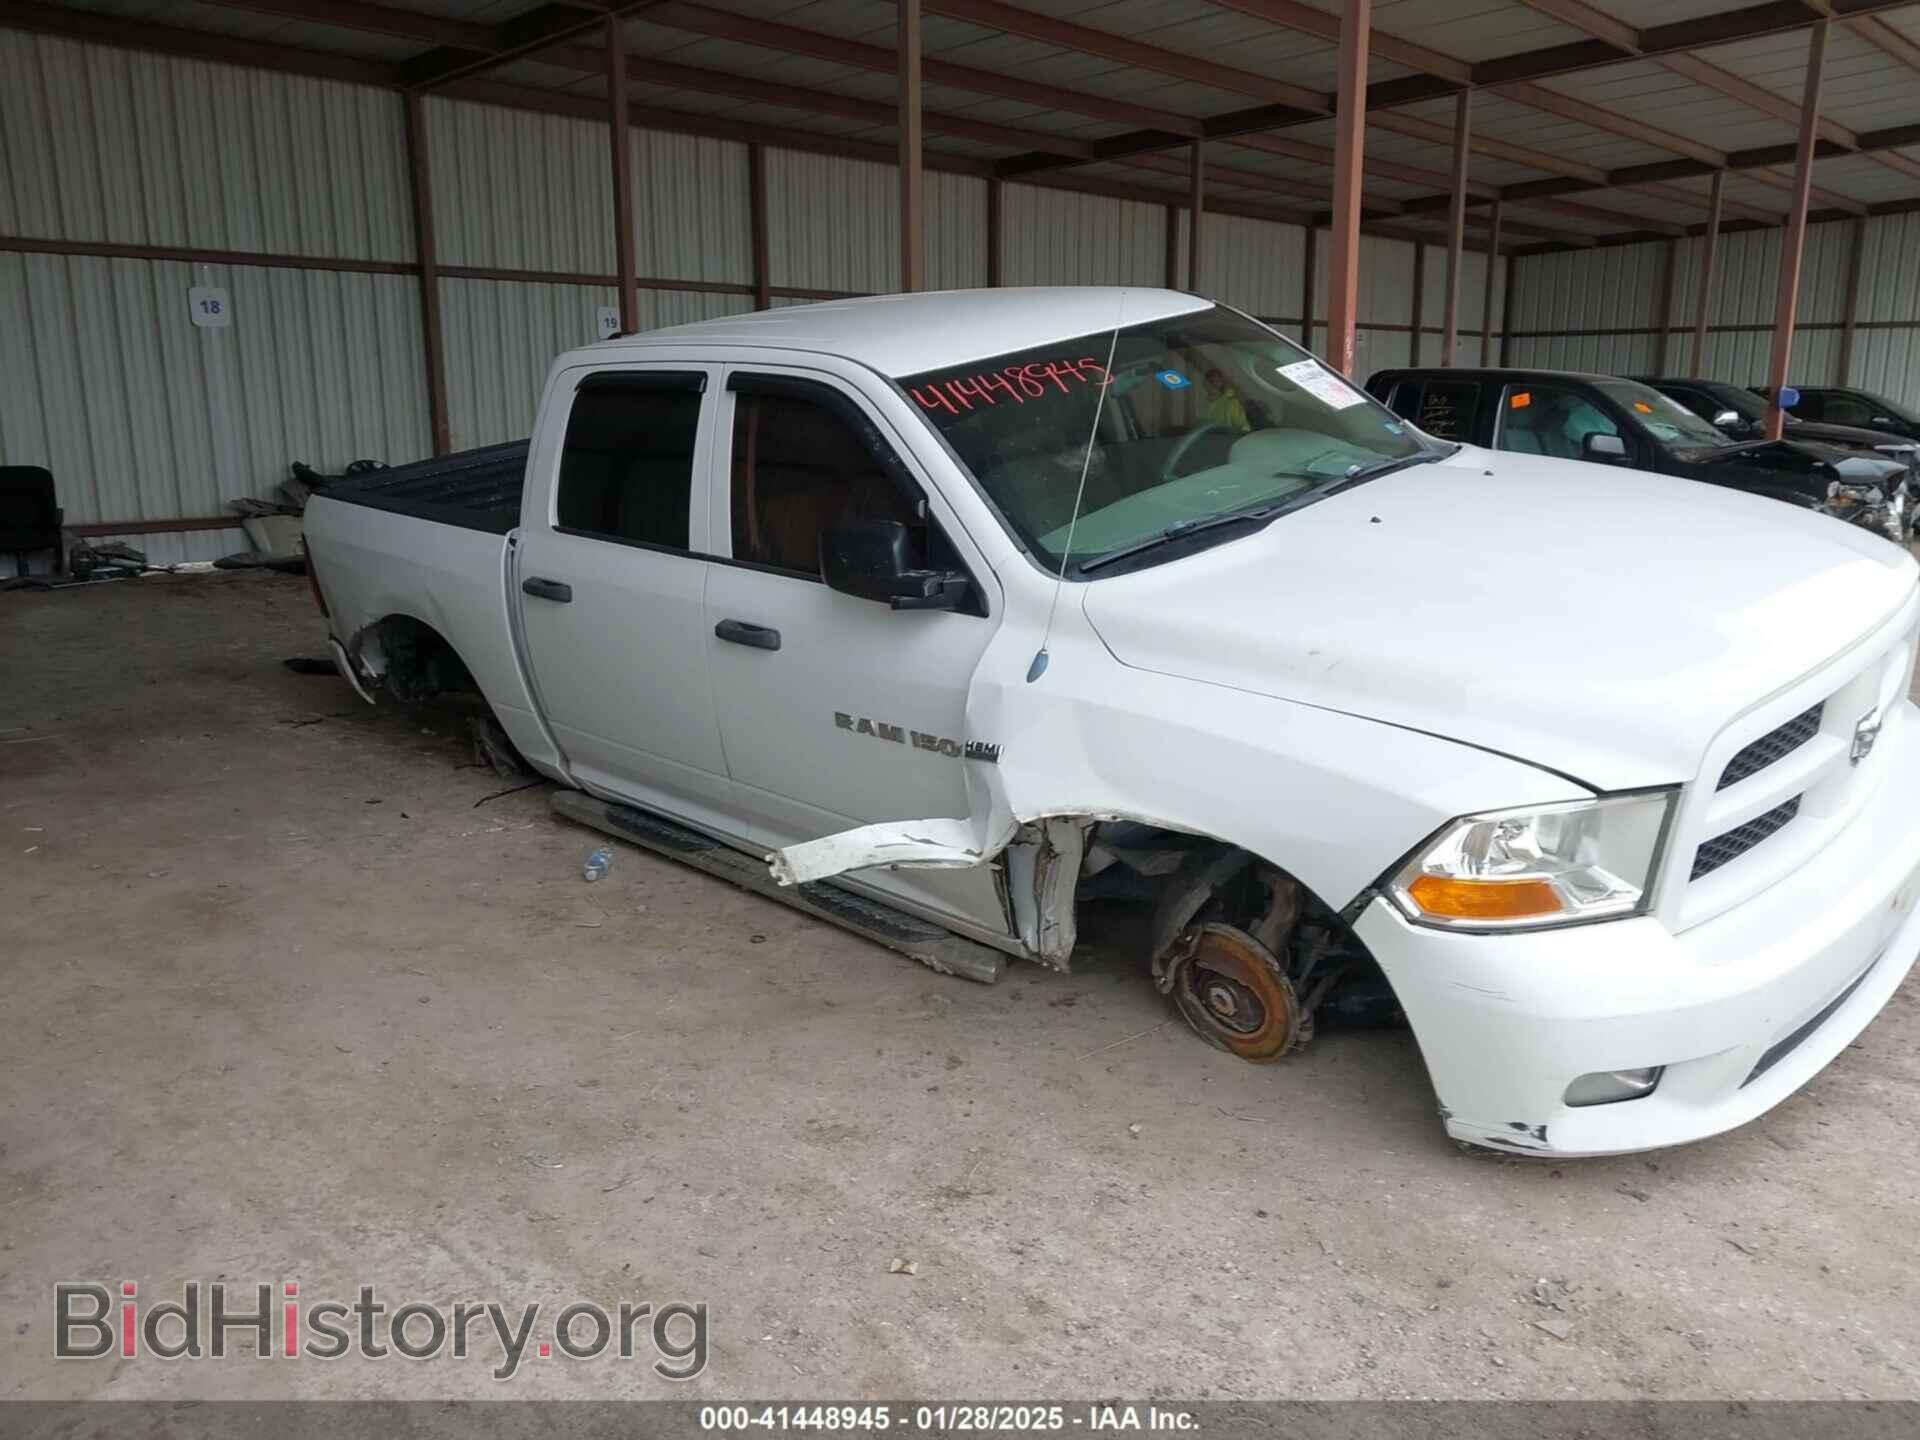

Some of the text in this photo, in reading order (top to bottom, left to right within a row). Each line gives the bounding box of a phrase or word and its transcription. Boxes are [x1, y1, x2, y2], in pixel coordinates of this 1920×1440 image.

[199, 300, 221, 315] 18
[603, 317, 617, 329] 19
[911, 358, 1115, 416] 41448945
[834, 711, 963, 758] RAM 150
